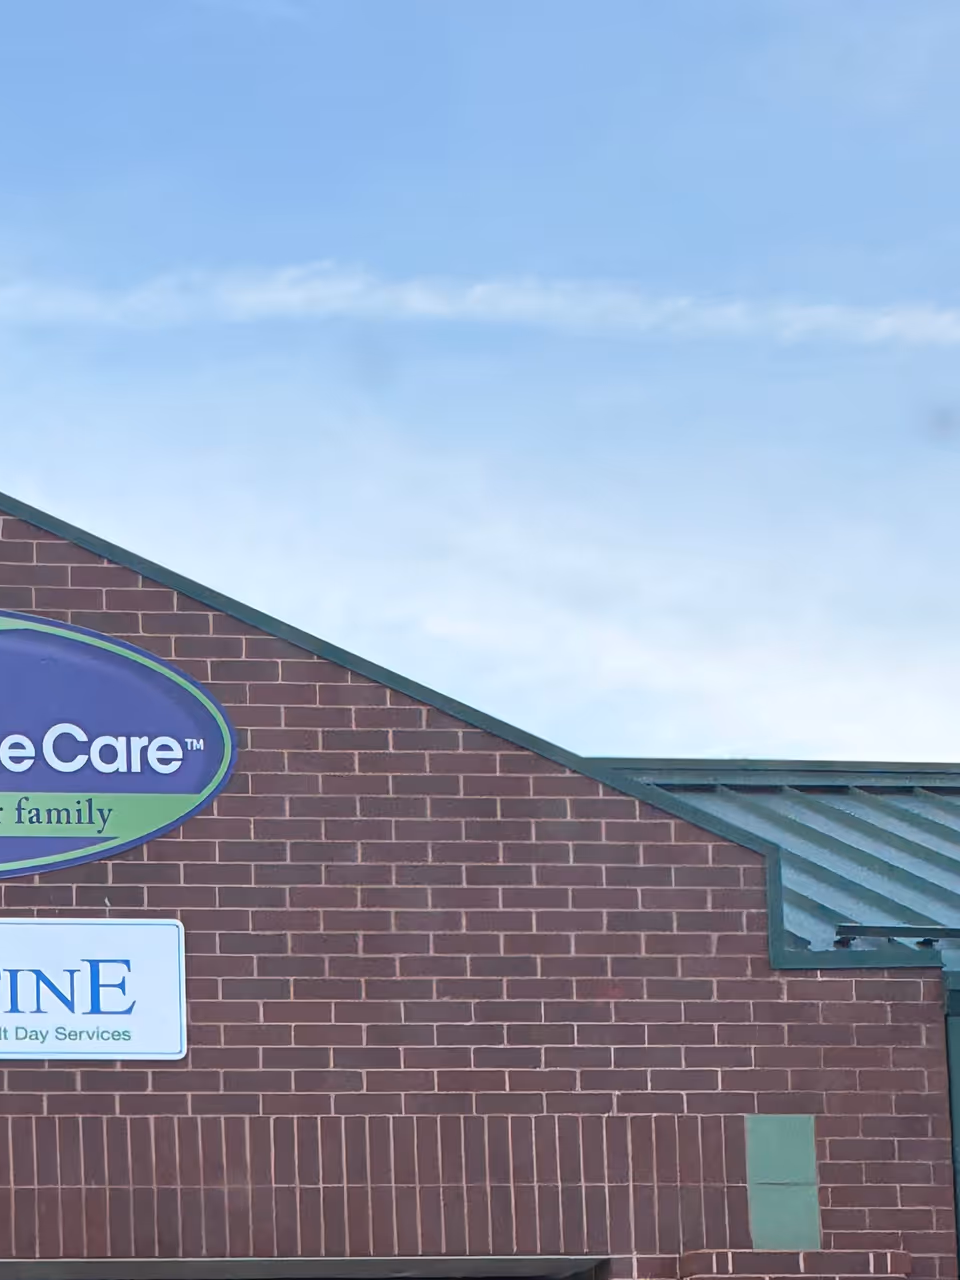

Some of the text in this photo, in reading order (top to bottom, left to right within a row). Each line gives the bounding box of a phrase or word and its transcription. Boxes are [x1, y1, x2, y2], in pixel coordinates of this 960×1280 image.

[15, 797, 113, 834] family
[15, 1027, 49, 1045] Day
[54, 1027, 132, 1042] Services
